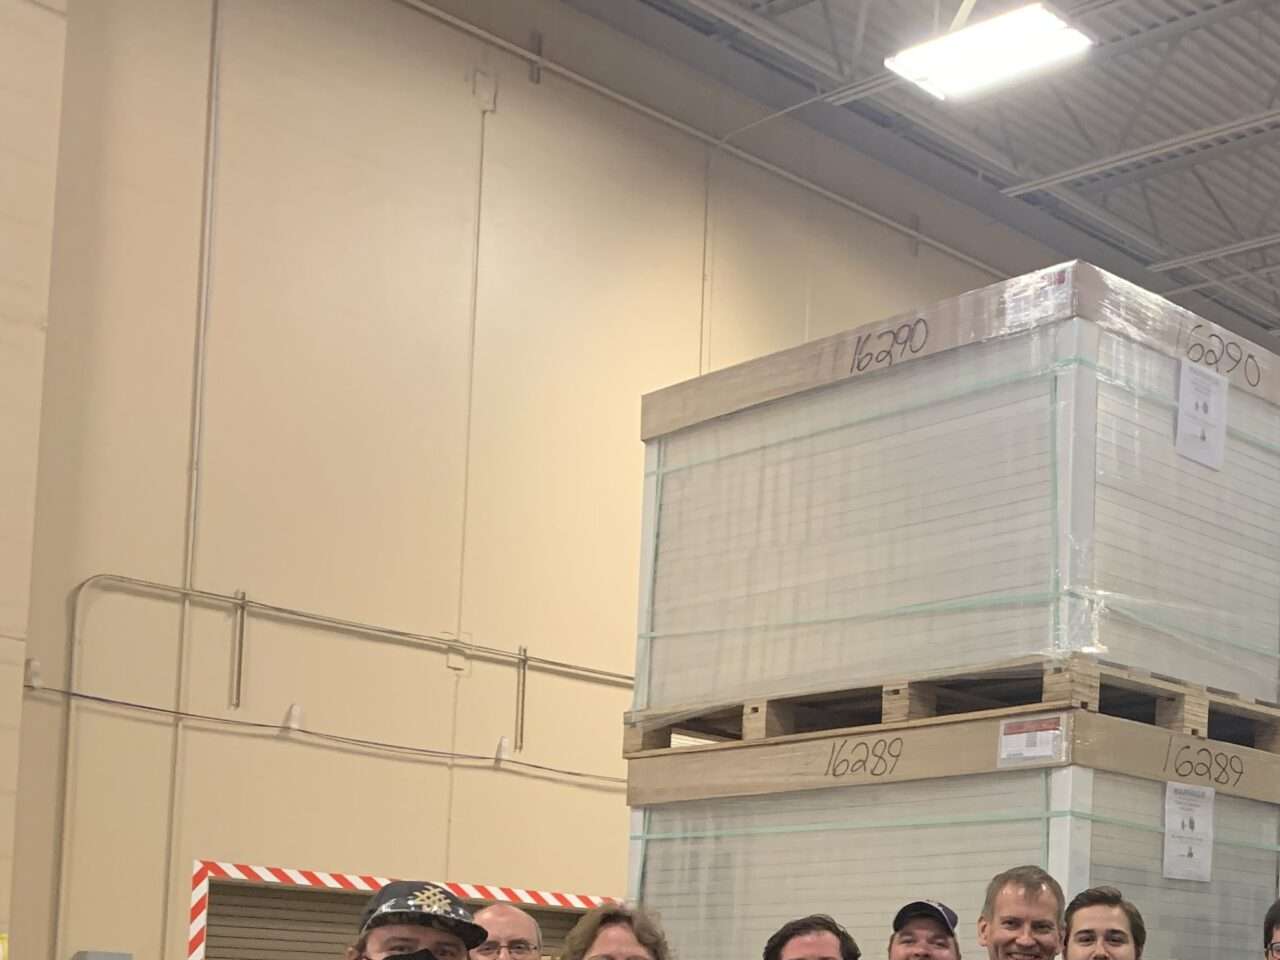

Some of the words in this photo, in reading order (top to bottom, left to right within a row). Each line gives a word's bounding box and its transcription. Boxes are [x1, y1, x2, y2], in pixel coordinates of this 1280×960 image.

[849, 318, 928, 374] 16290
[824, 737, 904, 777] 16289
[1163, 736, 1244, 787] 16289
